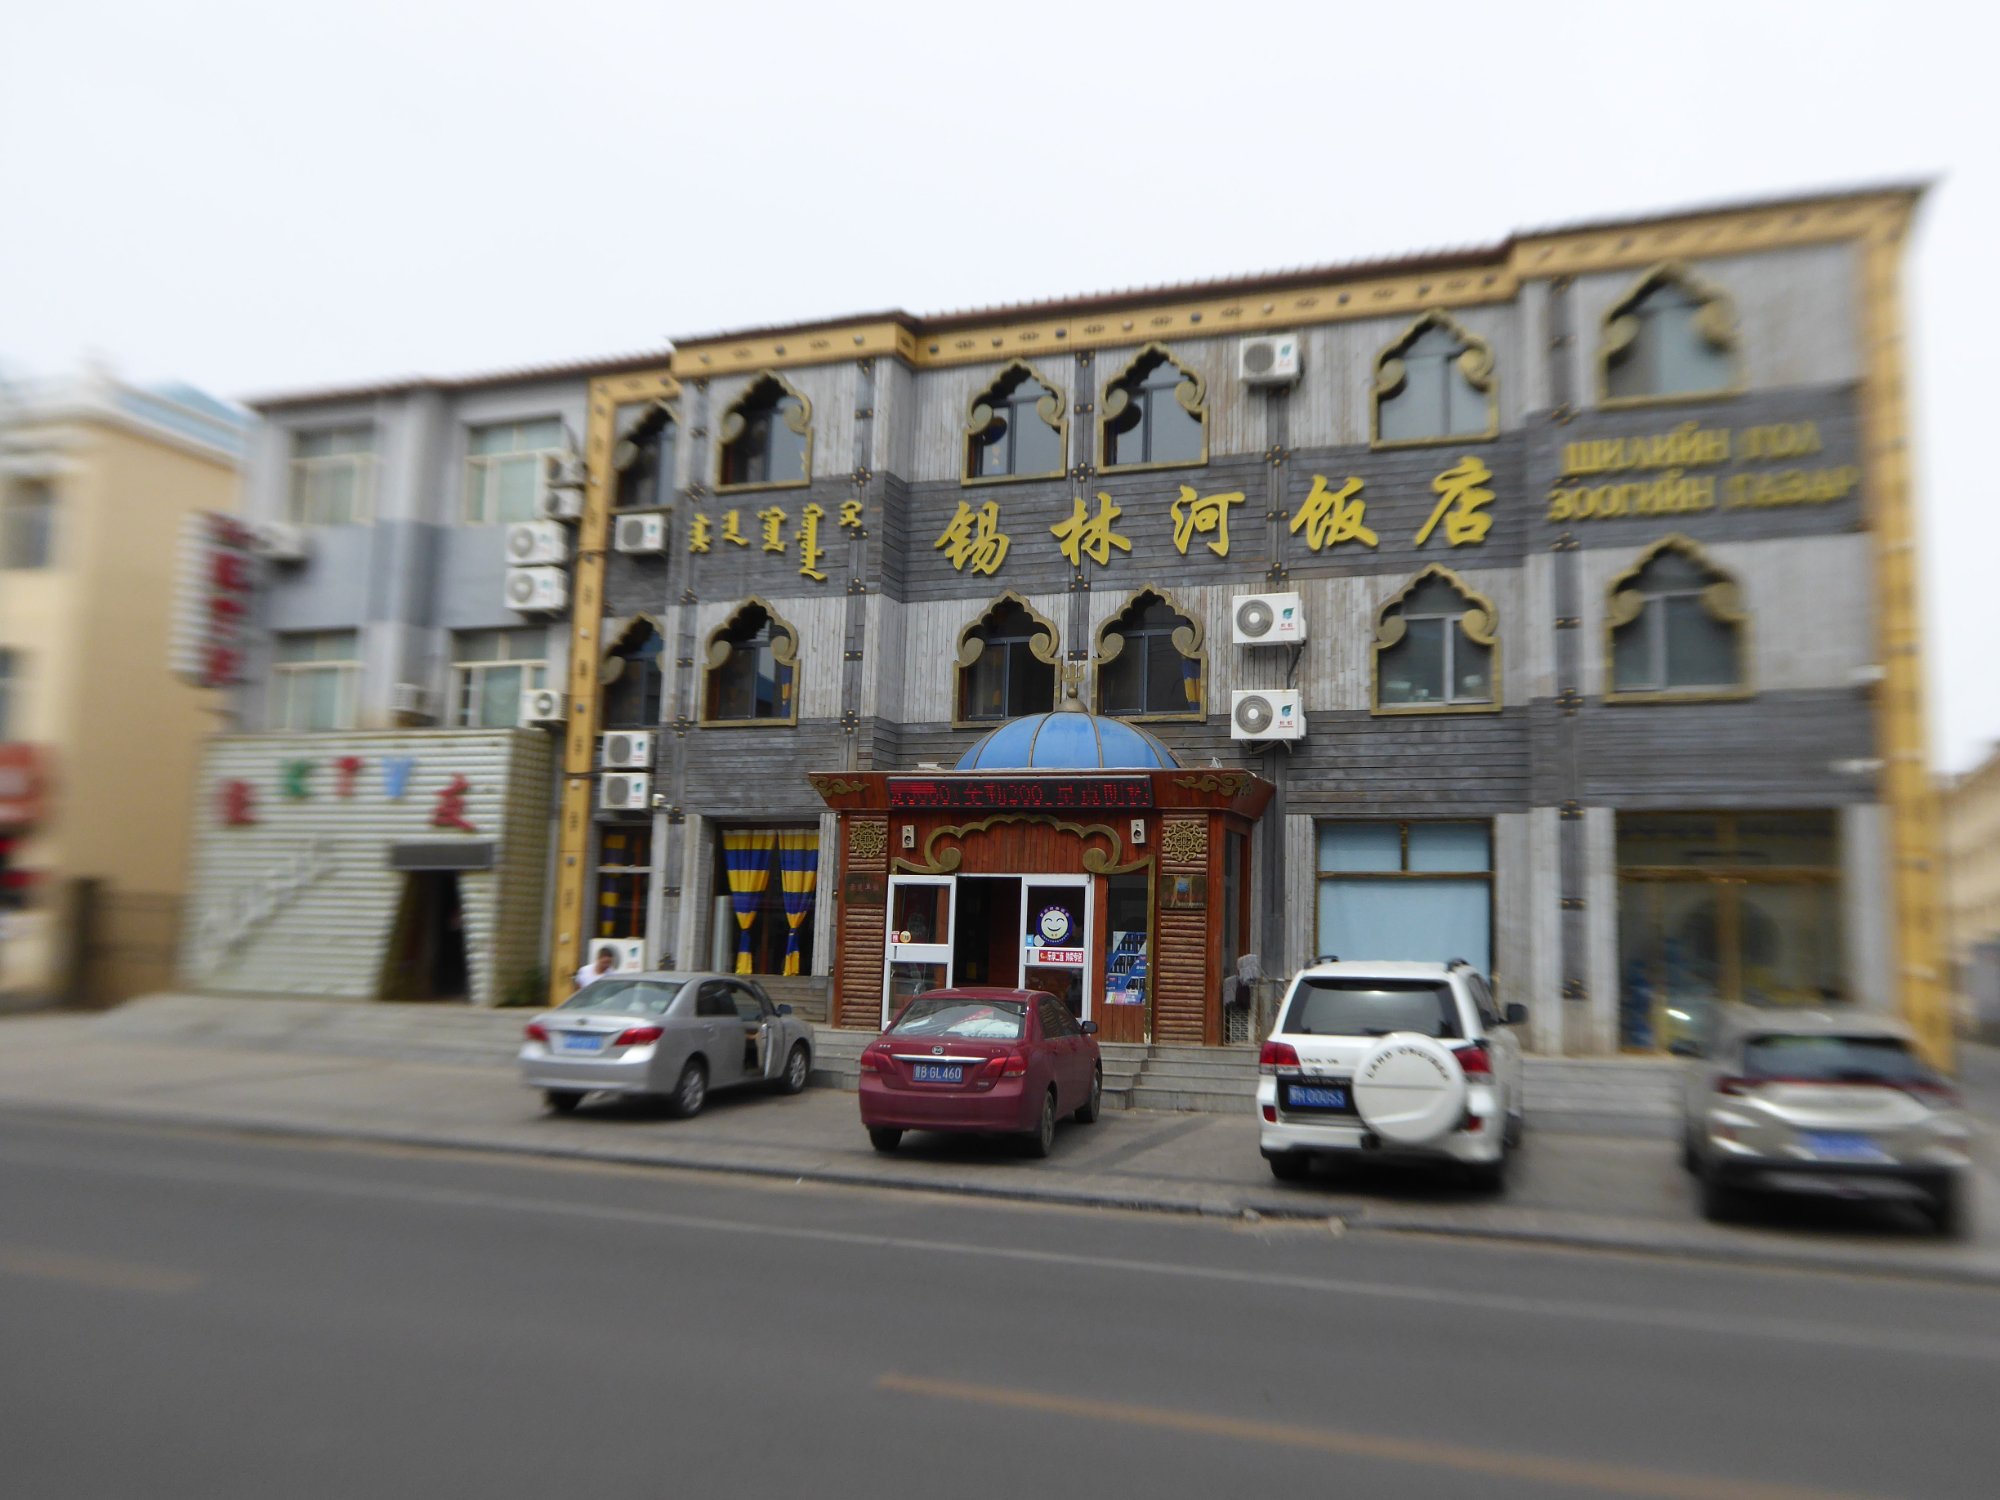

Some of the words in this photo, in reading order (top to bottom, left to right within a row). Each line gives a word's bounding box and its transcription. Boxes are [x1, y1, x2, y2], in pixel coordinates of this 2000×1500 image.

[936, 458, 1495, 575] 锡林河饭店
